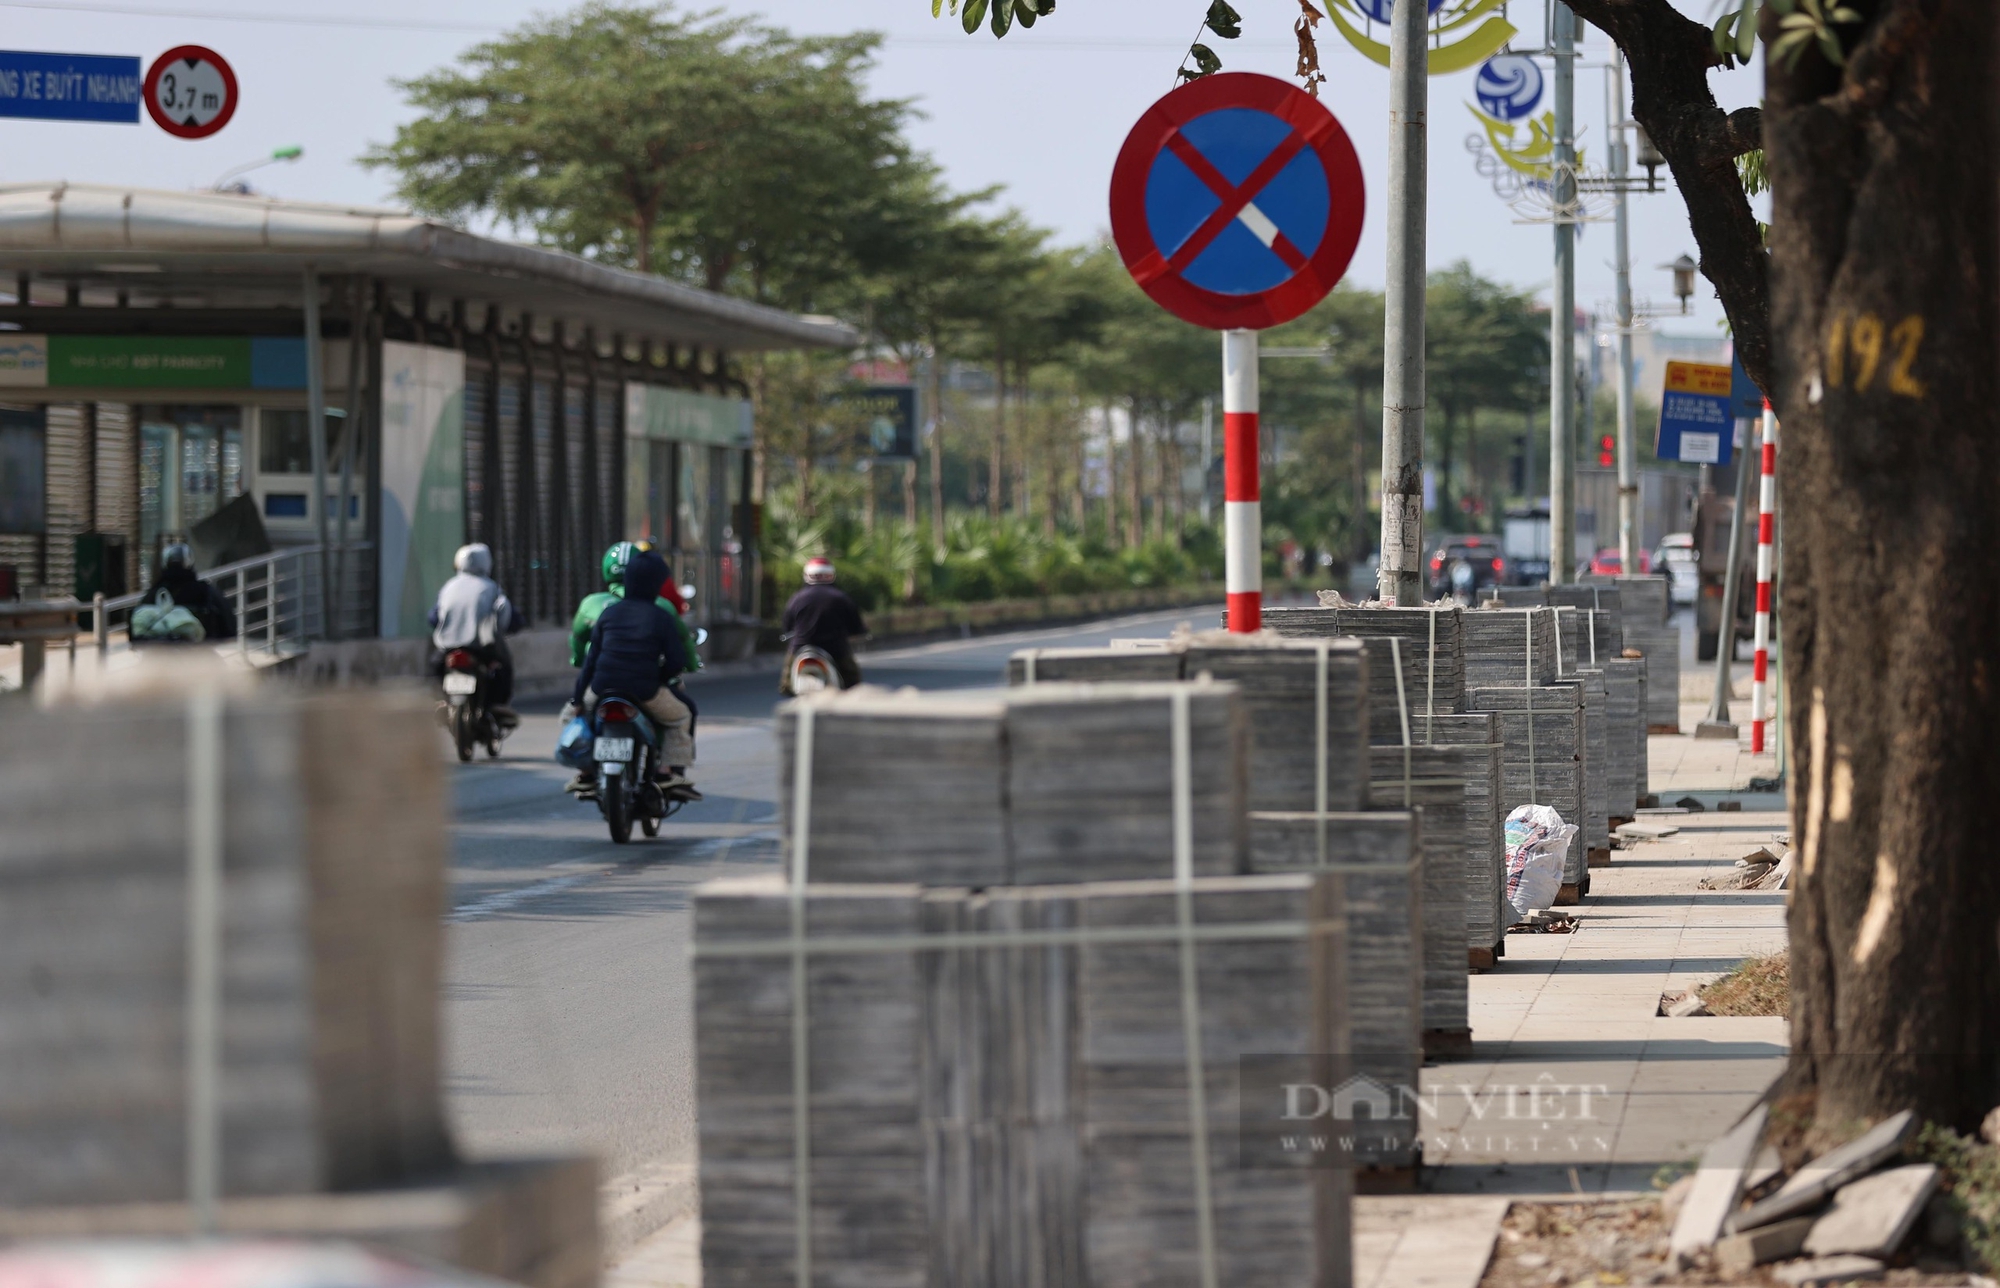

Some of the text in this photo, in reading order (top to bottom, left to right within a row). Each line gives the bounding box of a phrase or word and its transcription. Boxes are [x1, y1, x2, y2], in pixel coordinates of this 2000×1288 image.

[22, 70, 42, 100] XE
[45, 64, 84, 102] BUÝT
[87, 73, 139, 104] NHANH
[202, 93, 219, 110] m
[1826, 308, 1928, 399] 192
